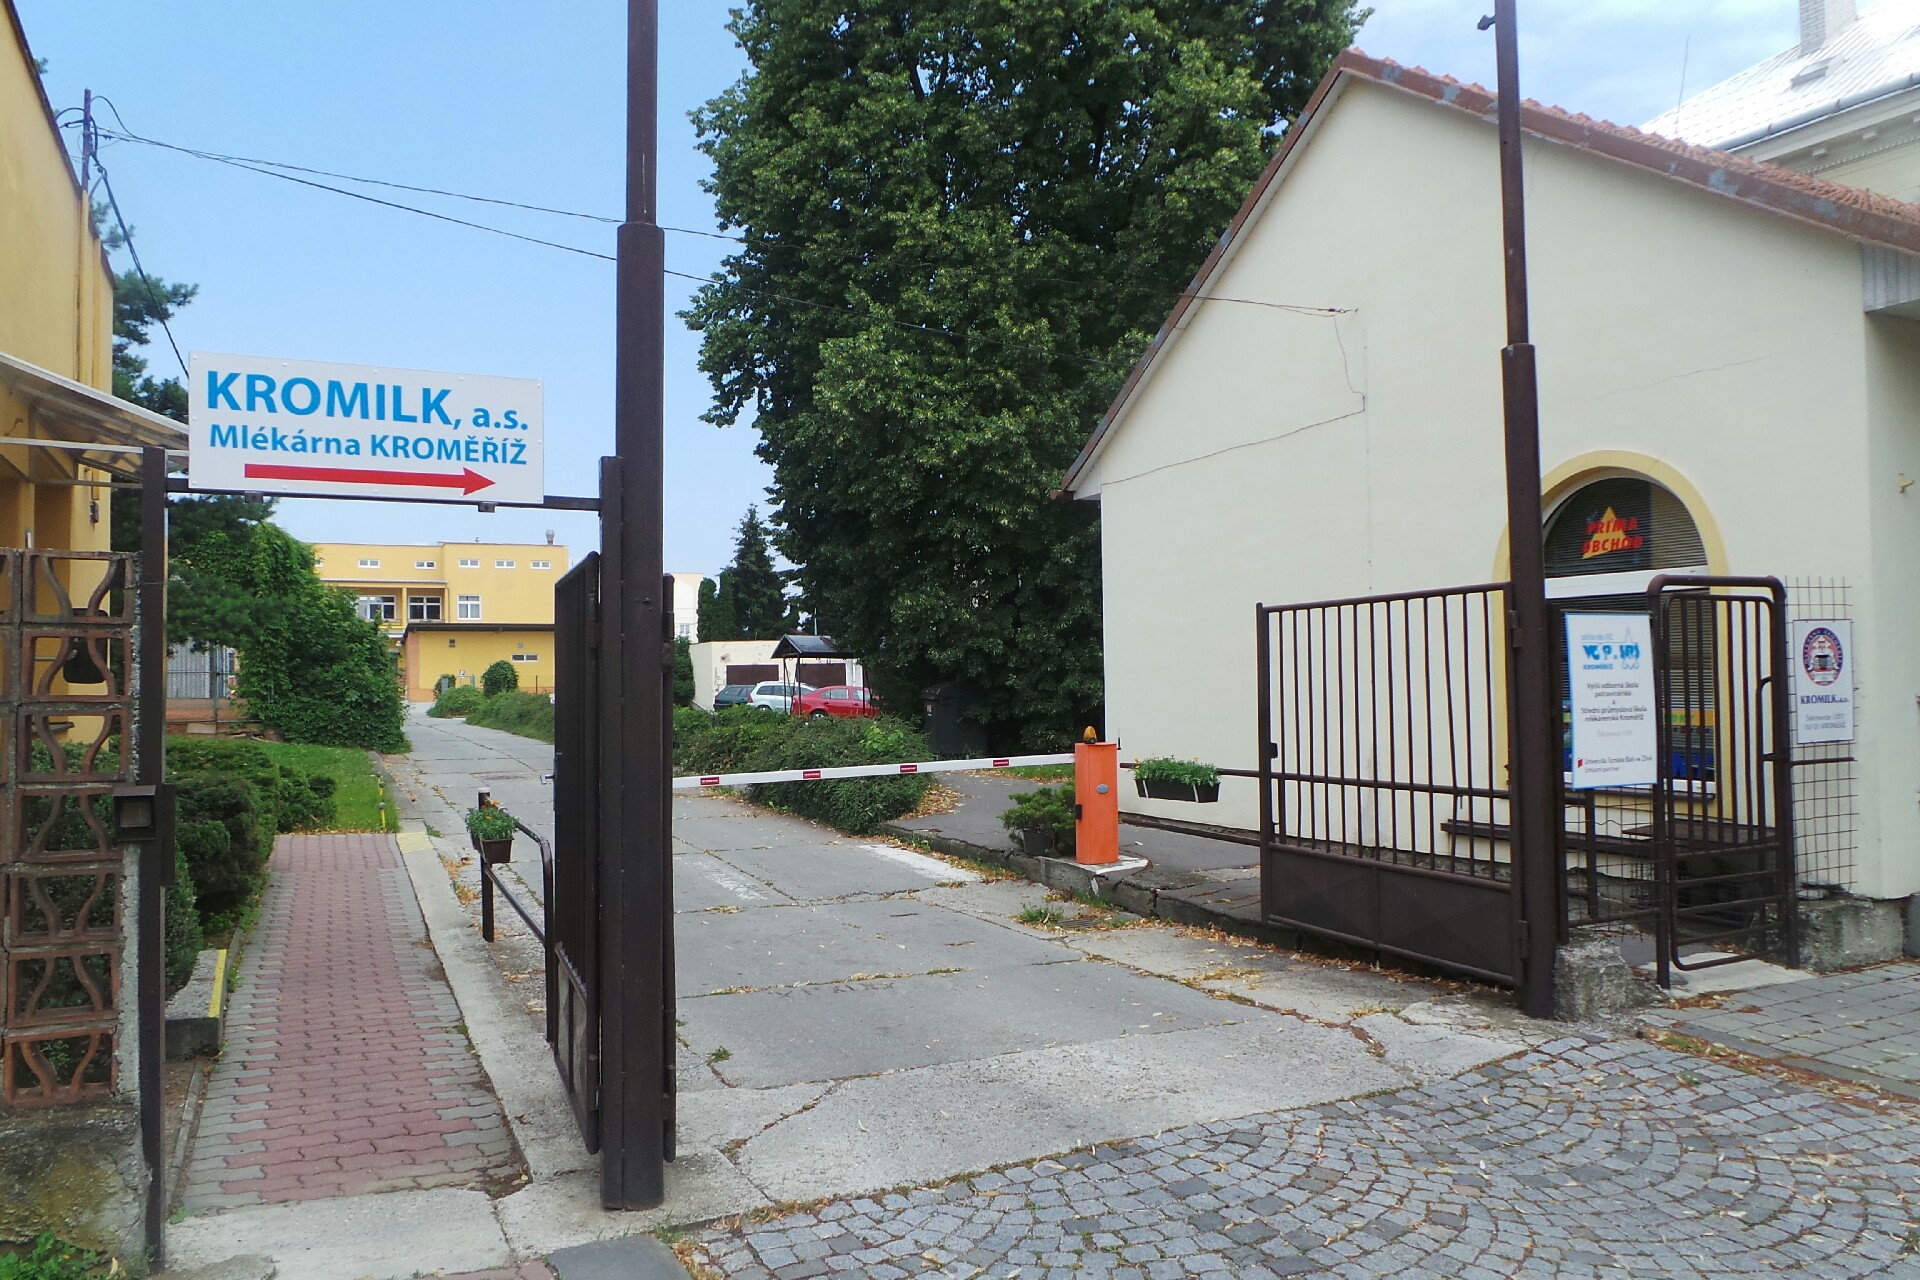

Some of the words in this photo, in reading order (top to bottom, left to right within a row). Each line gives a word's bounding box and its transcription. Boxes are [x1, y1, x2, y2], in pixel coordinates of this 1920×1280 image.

[207, 370, 462, 430] KROMILK,
[471, 406, 529, 431] a.s.
[209, 424, 361, 457] Mlékárna
[370, 433, 528, 466] KROMĚŘÍŽ
[1586, 517, 1638, 535] PRIMA
[1581, 535, 1644, 554] OBCHOD
